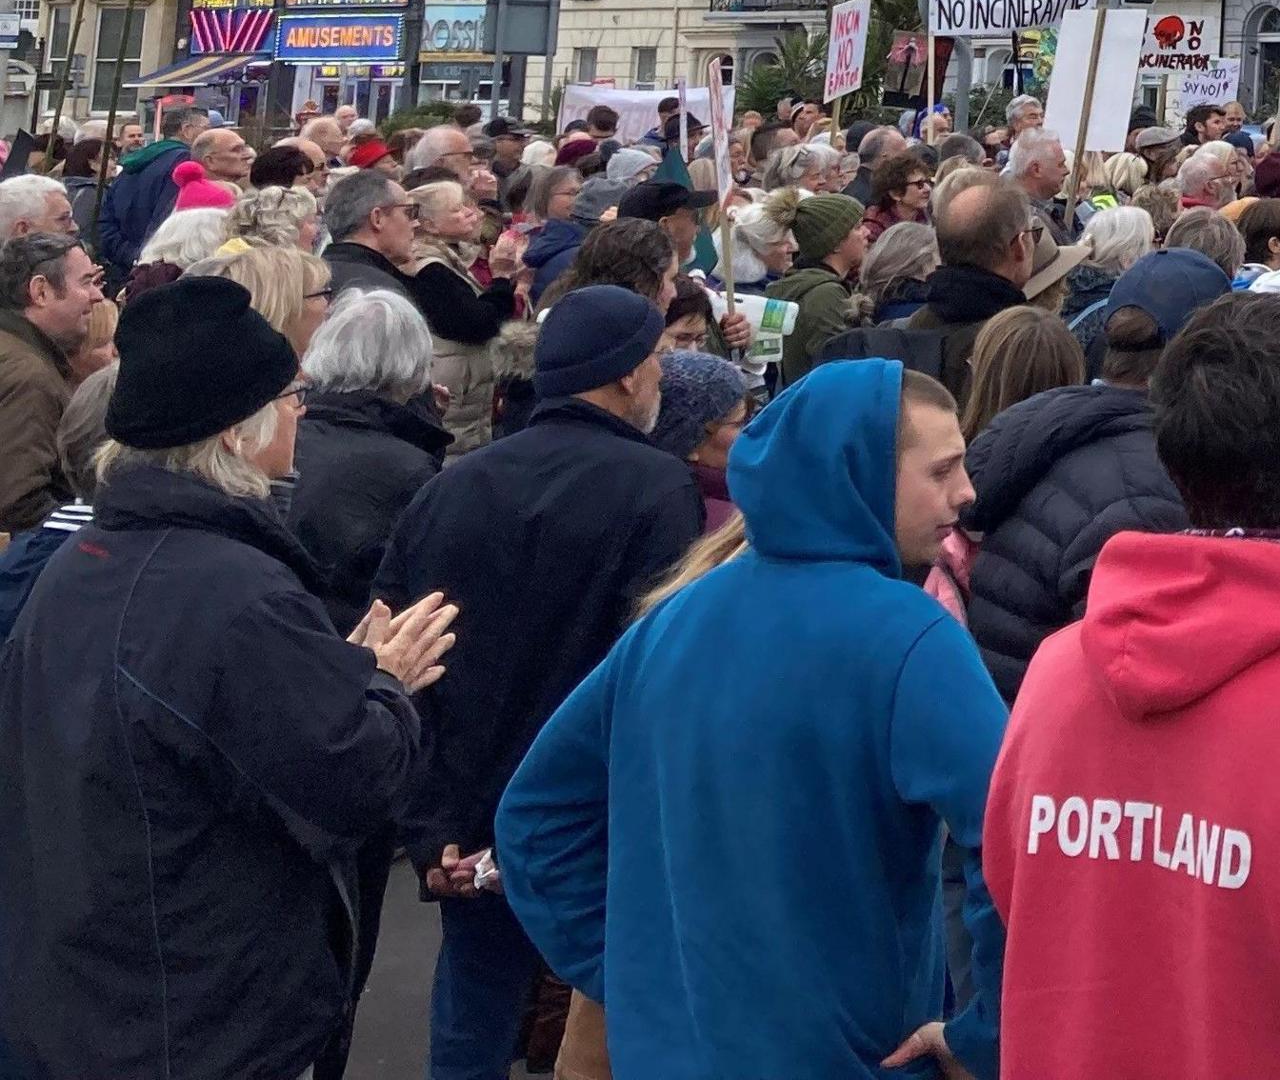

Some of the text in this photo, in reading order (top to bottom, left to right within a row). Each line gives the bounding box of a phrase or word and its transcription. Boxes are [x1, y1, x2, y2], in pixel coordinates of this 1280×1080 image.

[286, 25, 394, 47] AMUSEMENTS
[835, 38, 853, 75] NO
[1182, 81, 1199, 95] SAY
[1027, 794, 1252, 889] PORTLAND
